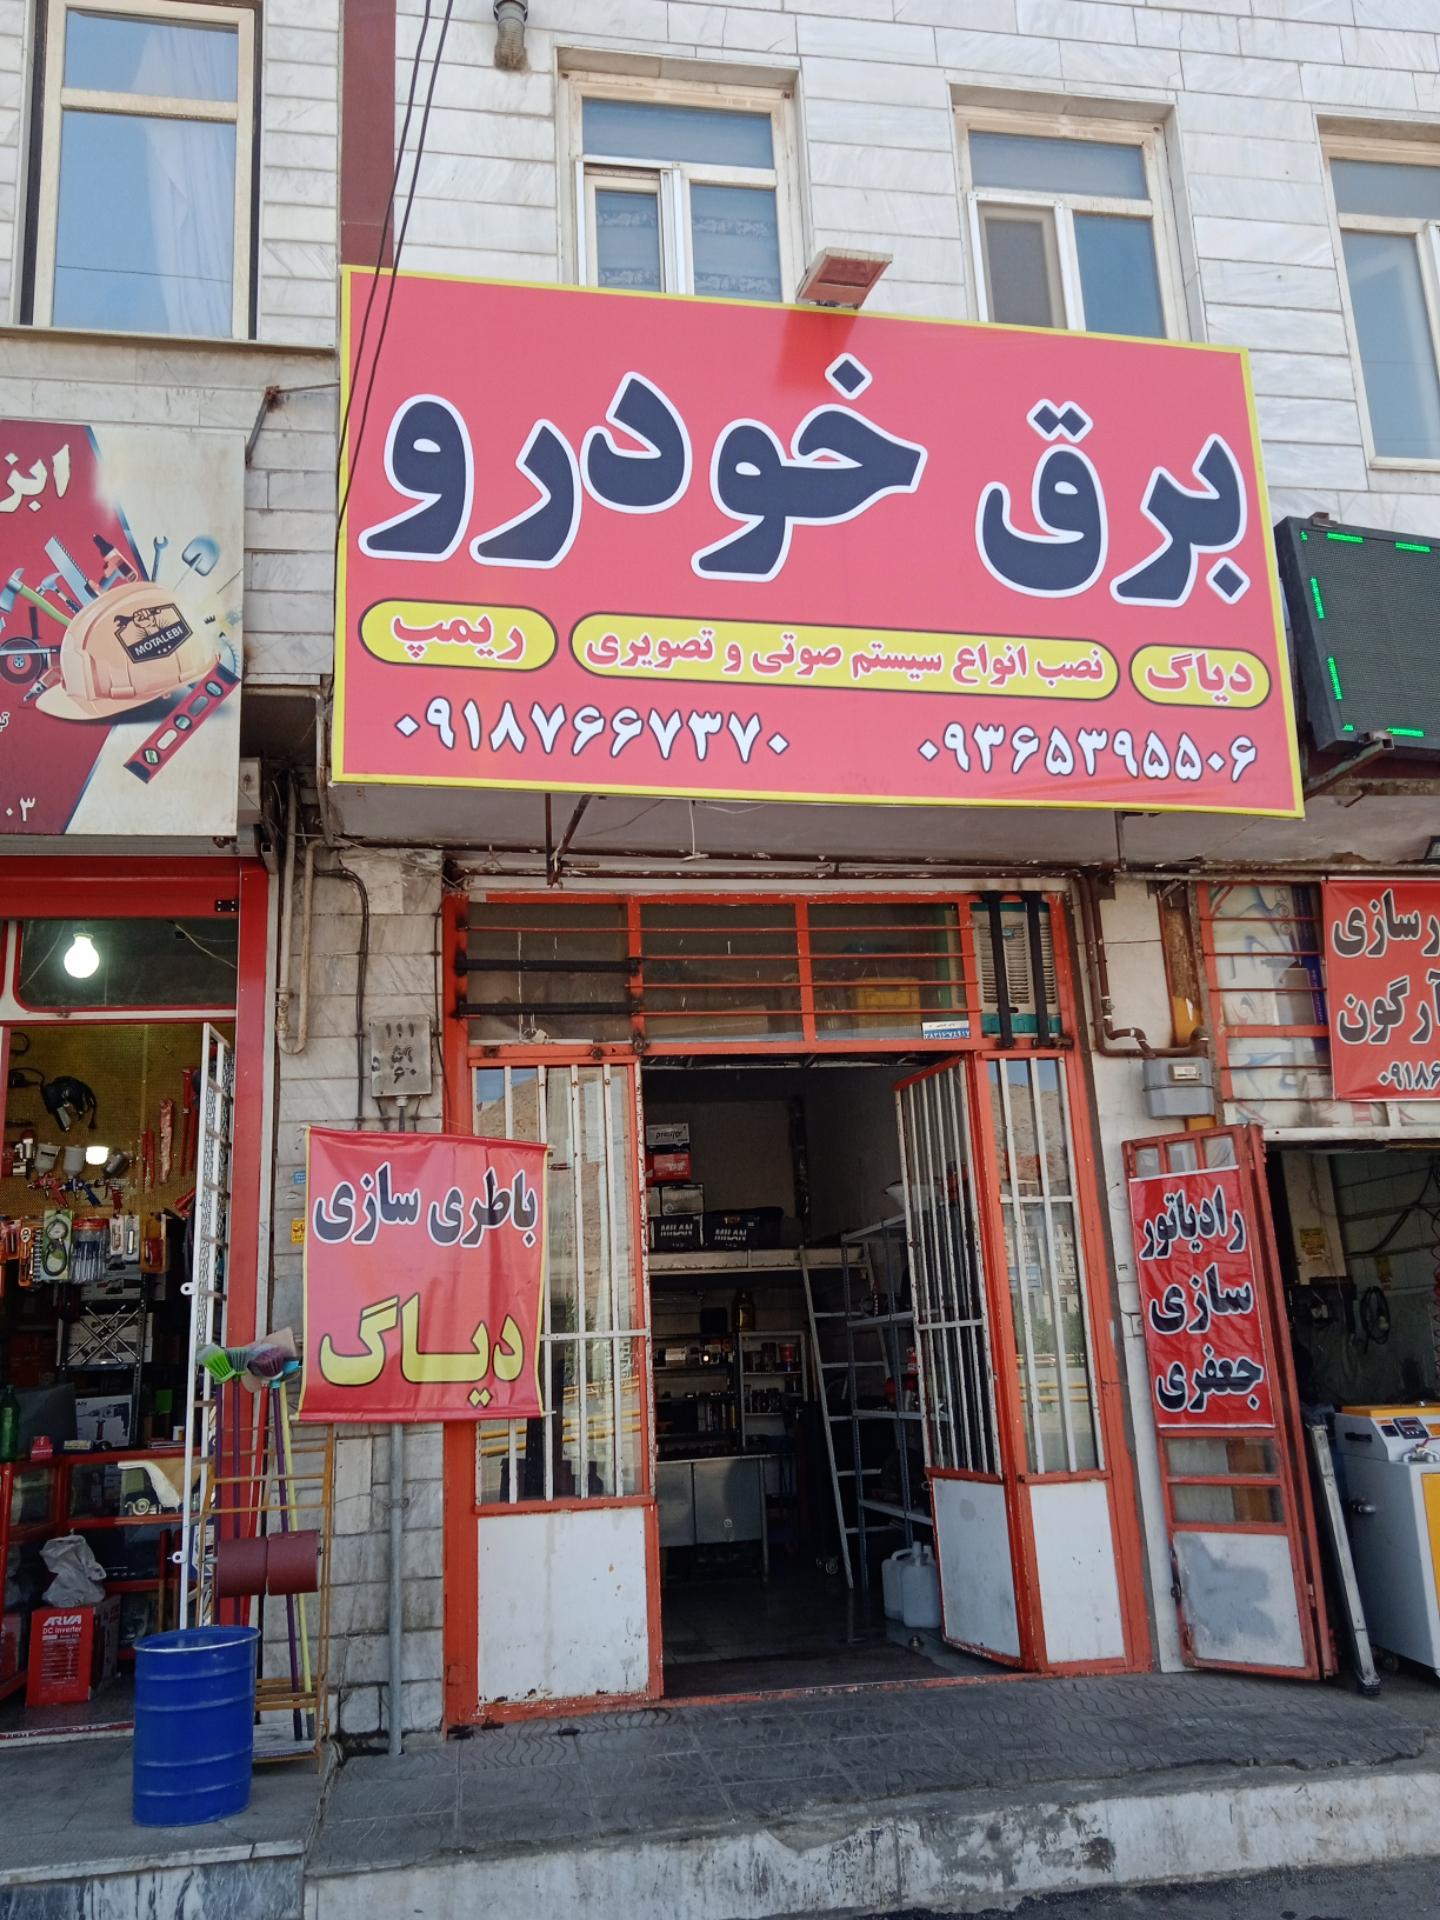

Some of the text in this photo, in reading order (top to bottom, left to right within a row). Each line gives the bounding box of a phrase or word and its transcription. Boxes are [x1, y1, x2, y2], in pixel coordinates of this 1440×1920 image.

[357, 352, 1250, 608] برق خودرو
[134, 625, 184, 657] MOTALEBI
[392, 613, 525, 661] ریمپ
[584, 626, 1106, 688] نصب انواع سیستم صوتی و تصویری
[1145, 652, 1255, 704] دیاگ
[394, 696, 791, 763] ۰۹۱۸۷۶۶۷۳۷۰
[918, 721, 1258, 783] ۰۹۳۶۵۳۹۵۵۰۶
[1332, 888, 1421, 958] سازی
[312, 1161, 538, 1249] باطری سازی
[1139, 1184, 1246, 1260] رادیاتور
[1149, 1262, 1253, 1335] سازی
[318, 1292, 525, 1409] دیاگ
[1156, 1344, 1264, 1414] جعفری
[43, 1615, 82, 1626] ARVA
